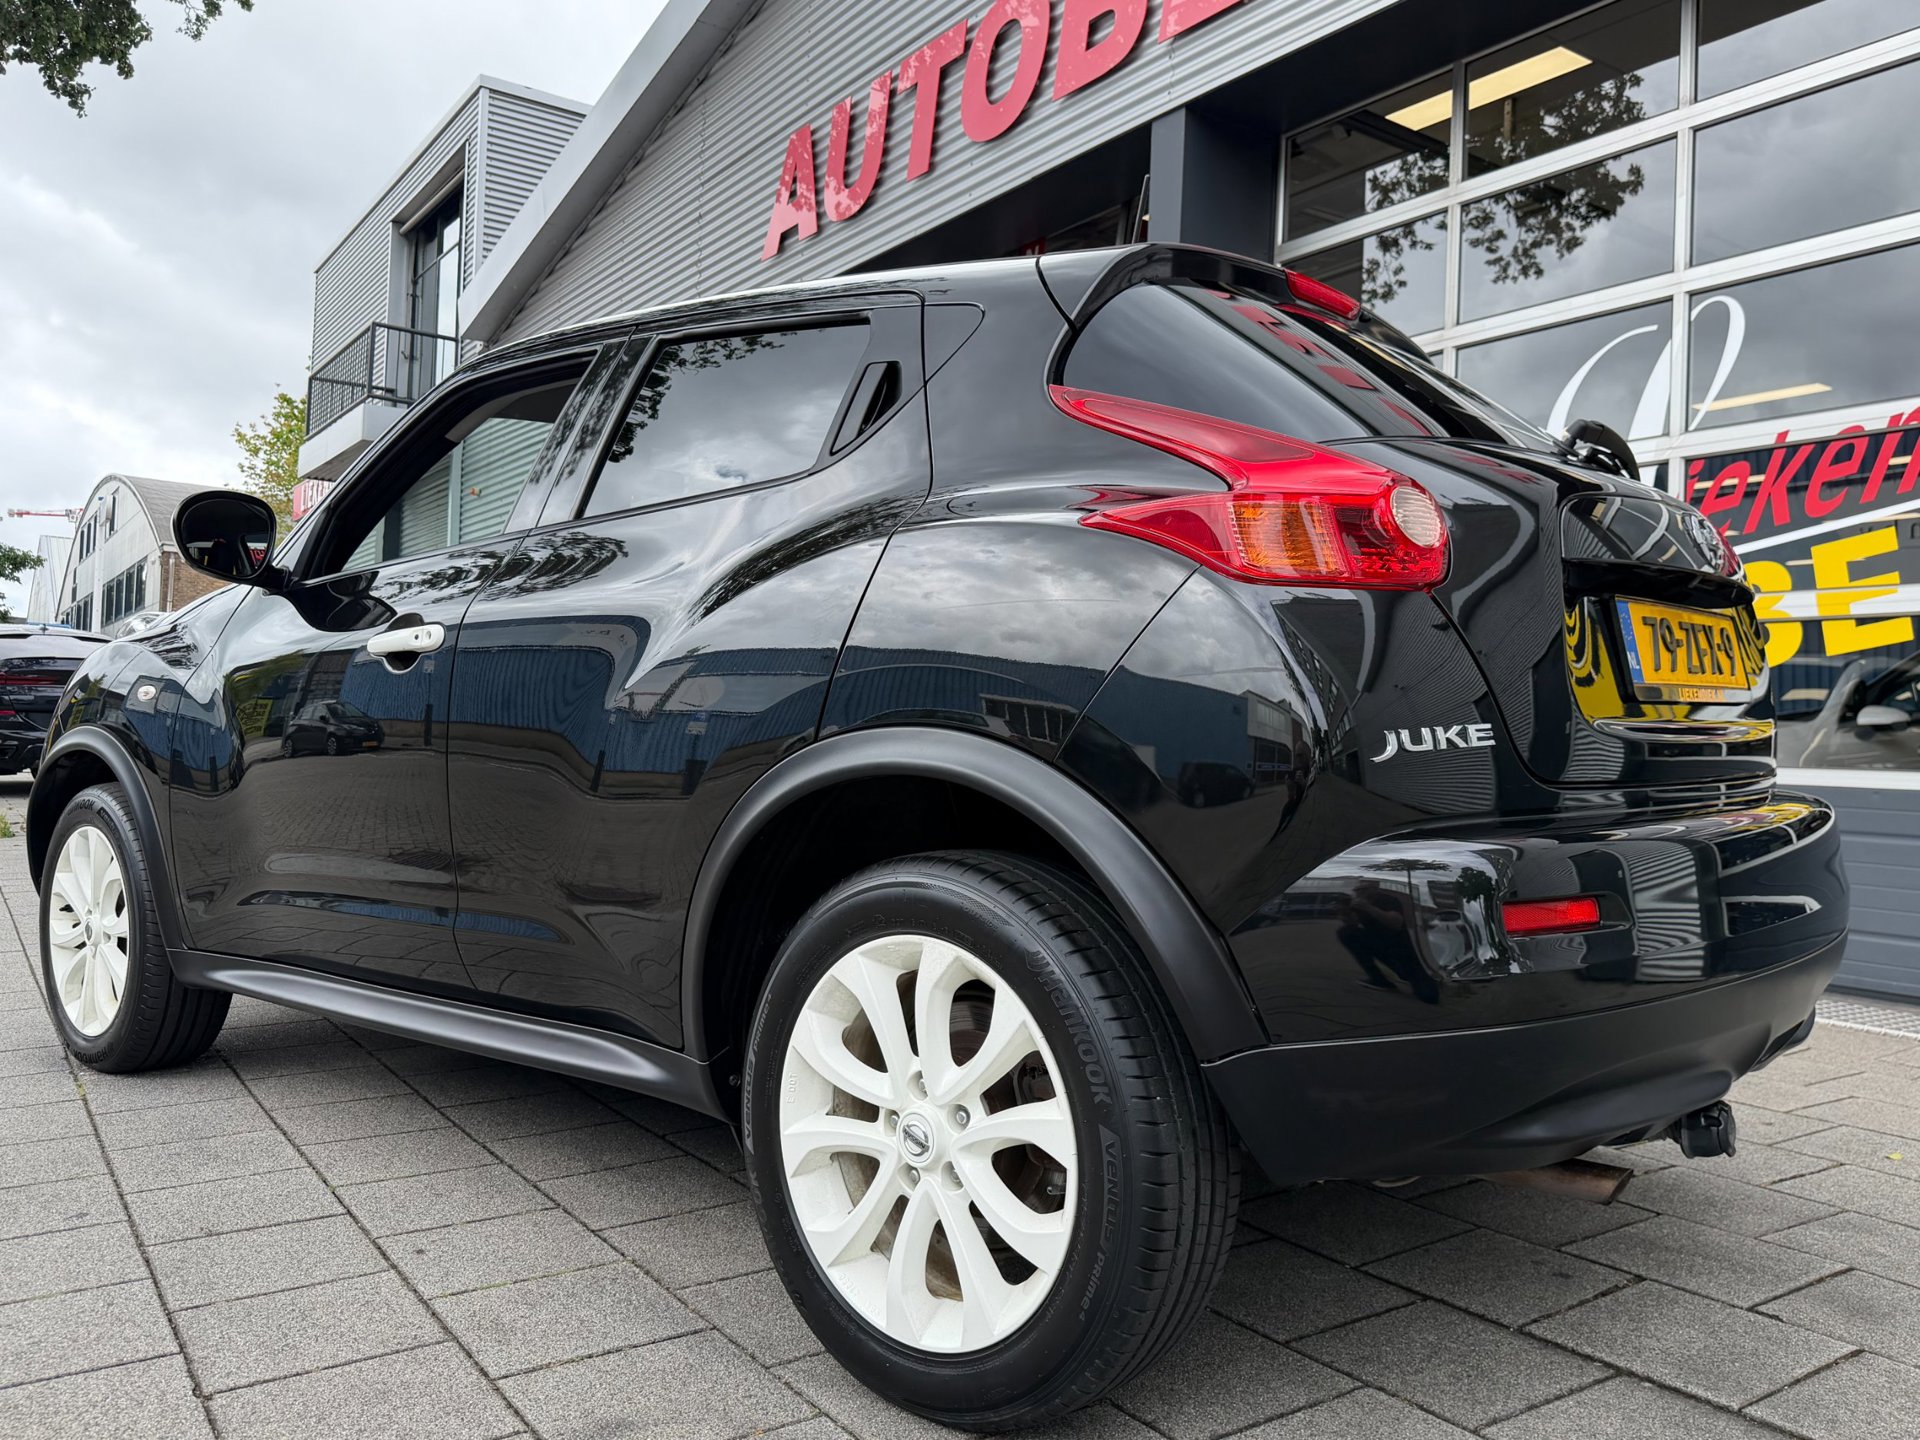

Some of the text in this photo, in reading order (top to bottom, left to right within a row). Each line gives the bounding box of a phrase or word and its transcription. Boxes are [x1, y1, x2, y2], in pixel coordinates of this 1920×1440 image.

[1627, 651, 1641, 670] NL
[1641, 616, 1736, 677] 79-ZFX-9
[1370, 723, 1496, 762] JUKE
